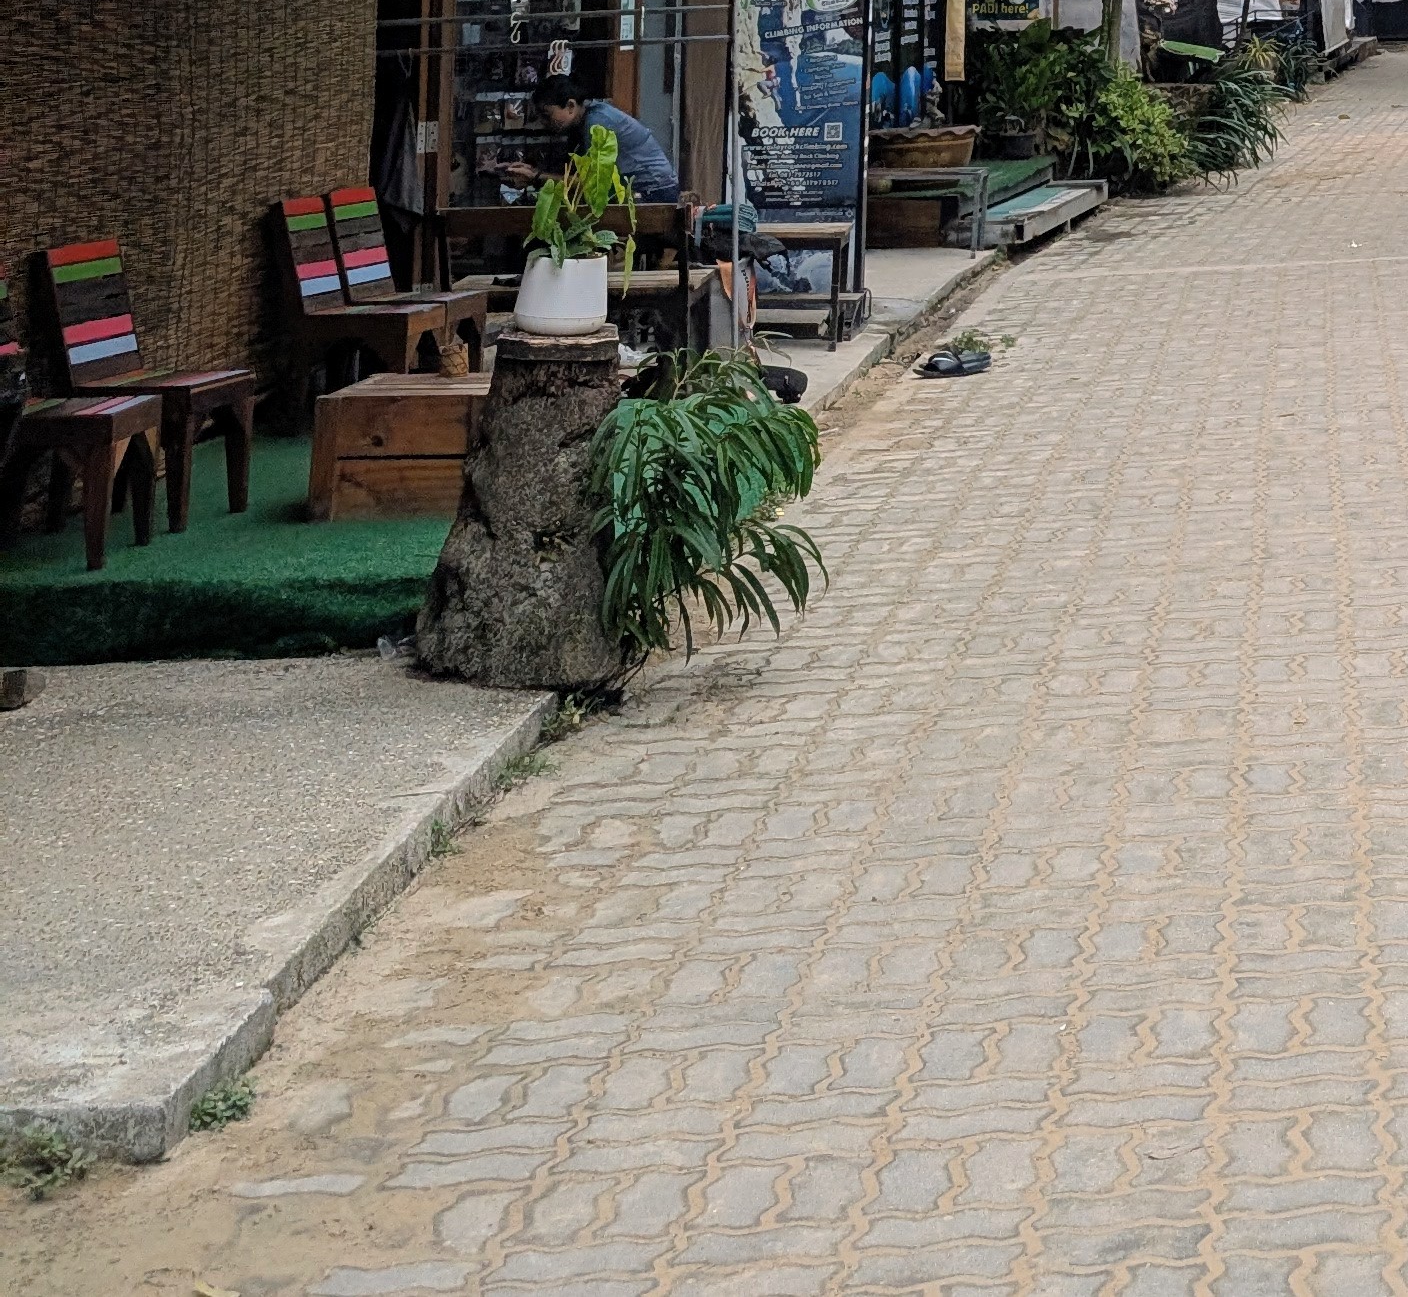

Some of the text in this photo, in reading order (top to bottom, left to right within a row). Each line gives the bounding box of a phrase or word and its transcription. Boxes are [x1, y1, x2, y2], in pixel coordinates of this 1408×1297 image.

[972, 4, 1029, 14] PADI here!
[764, 16, 864, 39] CLIMBING INFORMATION
[751, 127, 821, 137] BOOK HERE
